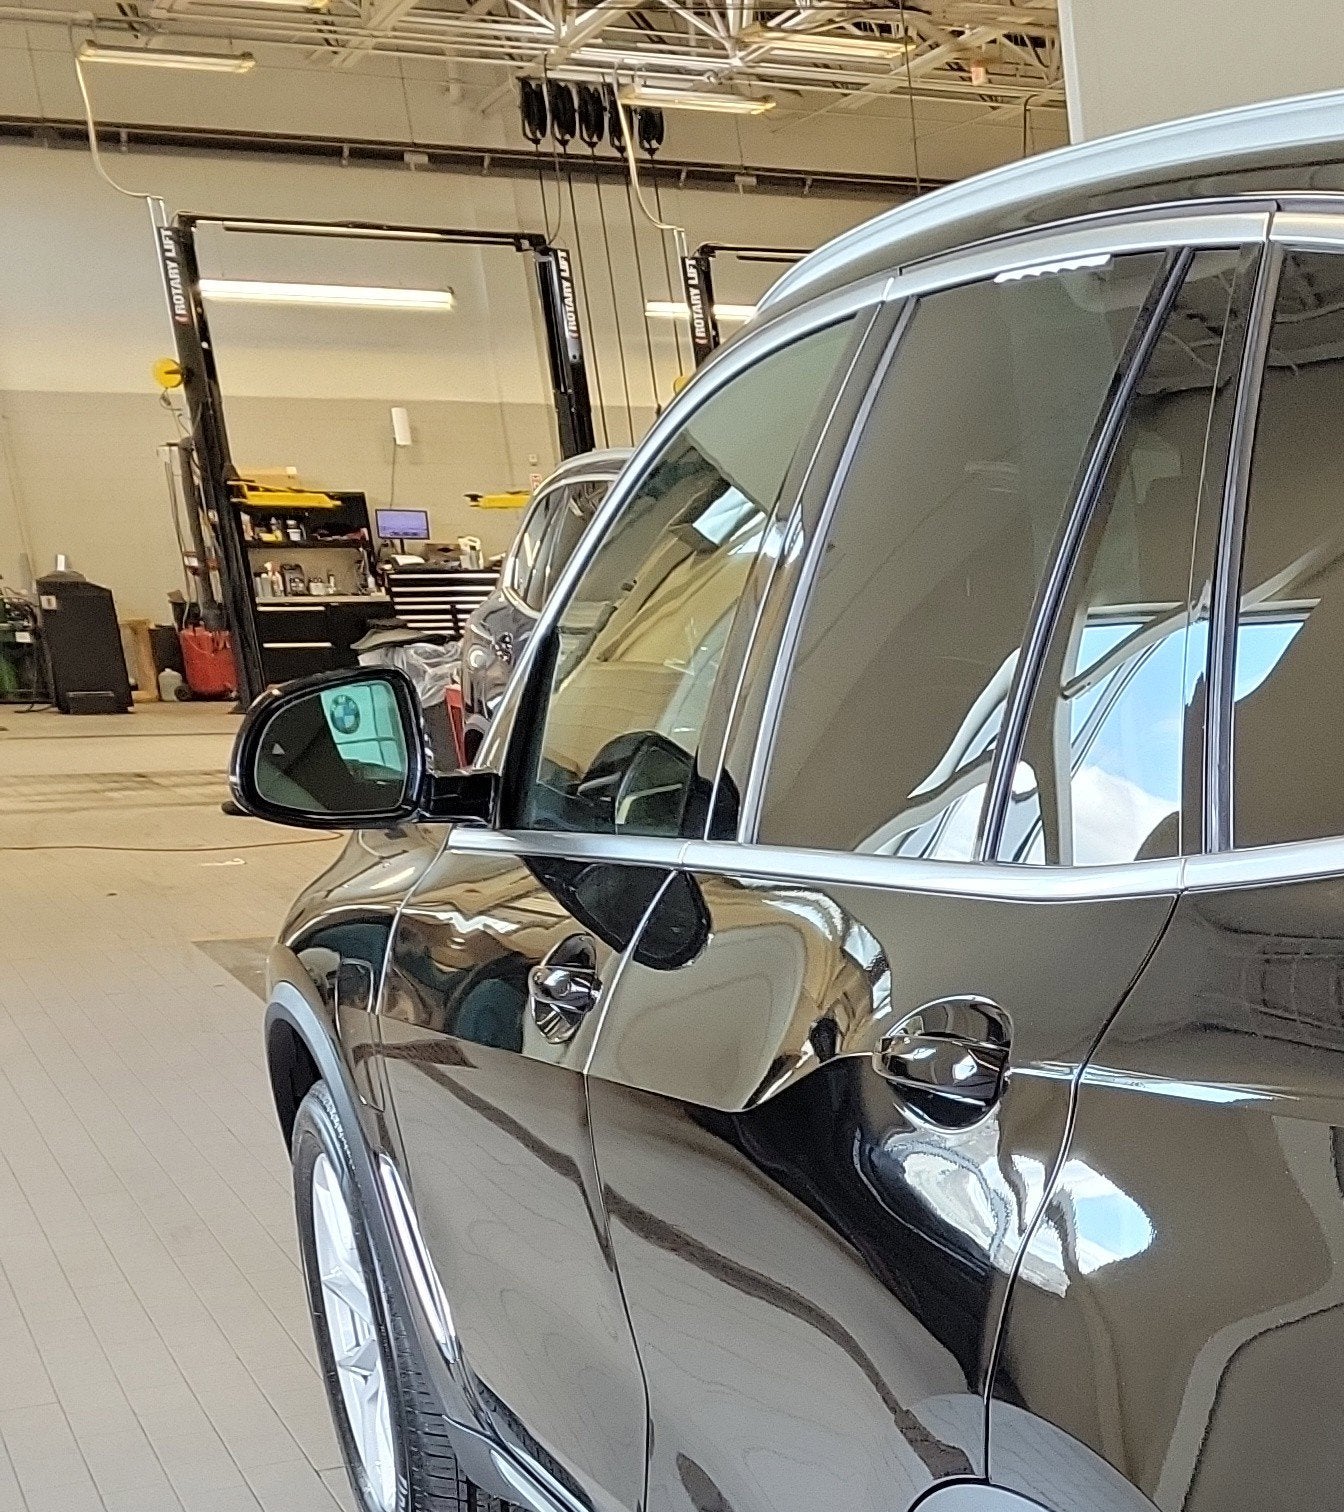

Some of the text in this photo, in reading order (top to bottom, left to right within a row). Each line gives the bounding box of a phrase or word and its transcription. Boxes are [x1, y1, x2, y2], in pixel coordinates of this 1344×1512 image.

[160, 228, 187, 314] ROTARY LIFT
[557, 249, 578, 330] ROTARY LIFT
[685, 258, 706, 337] ROTARY LIFT
